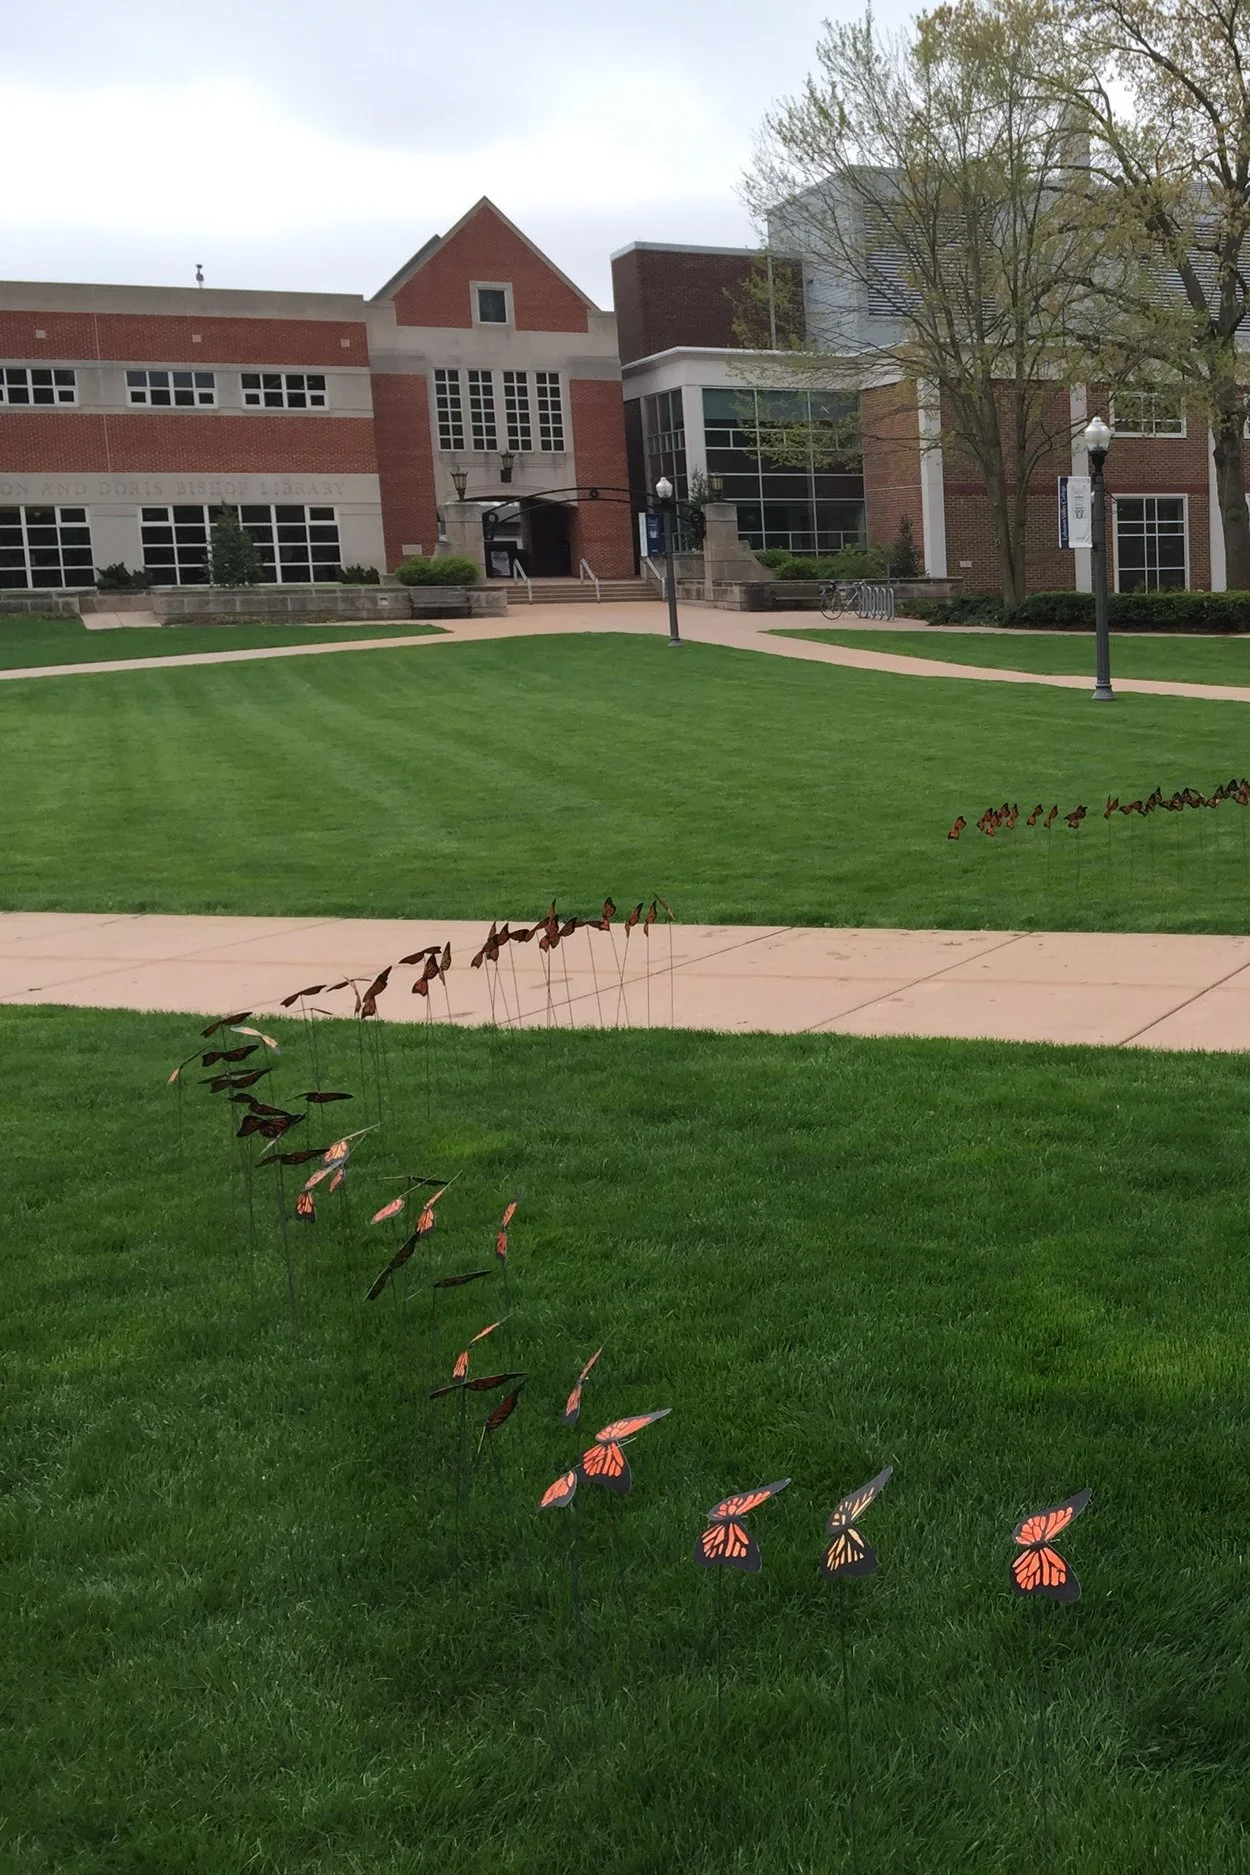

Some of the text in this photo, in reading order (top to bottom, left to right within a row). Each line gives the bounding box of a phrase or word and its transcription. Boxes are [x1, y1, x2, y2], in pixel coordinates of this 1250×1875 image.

[41, 481, 87, 496] AND
[99, 481, 163, 496] DORIS
[177, 481, 248, 496] BISHOP
[260, 481, 345, 496] LIBRARY
